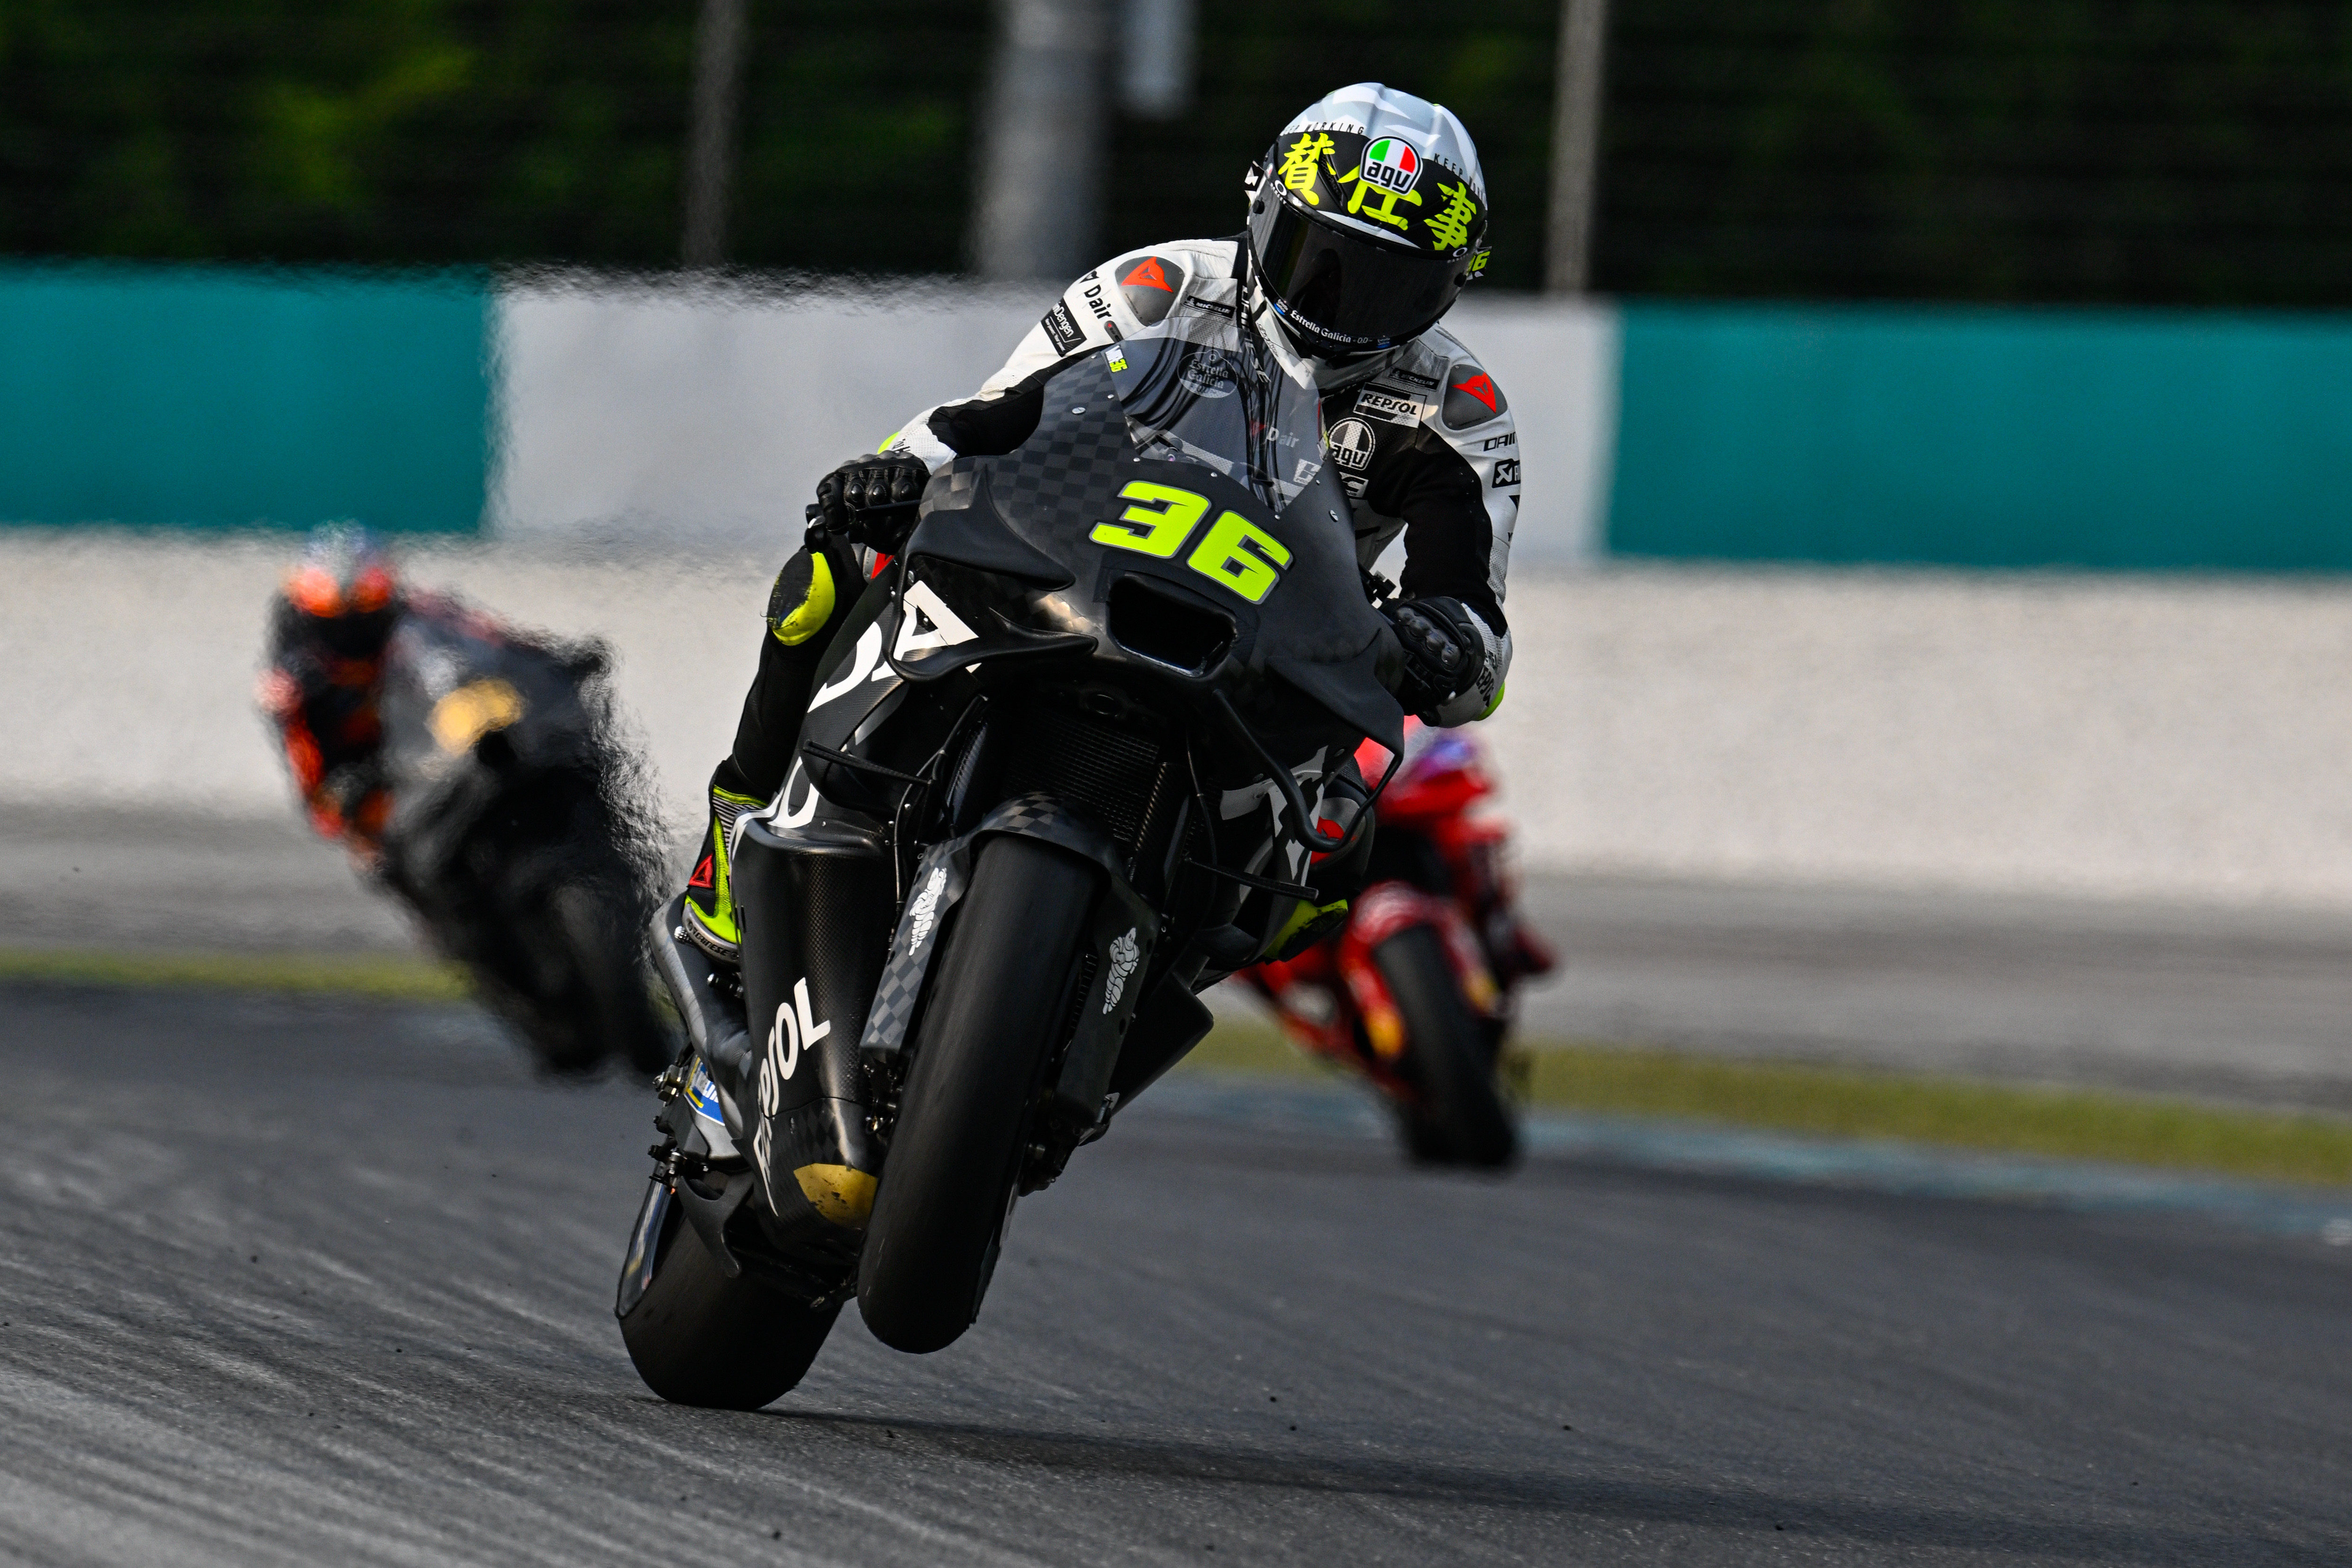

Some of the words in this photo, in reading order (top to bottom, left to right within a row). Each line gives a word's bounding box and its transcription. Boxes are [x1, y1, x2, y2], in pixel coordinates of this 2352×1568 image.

[1366, 161, 1411, 188] agv
[1434, 153, 1463, 177] KEEP
[1290, 310, 1320, 334] Estrella
[1321, 328, 1351, 343] Galicia
[1187, 369, 1224, 389] Galicia
[1189, 359, 1229, 378] Estrella
[1361, 393, 1417, 415] REPSOL
[1089, 480, 1294, 605] 36
